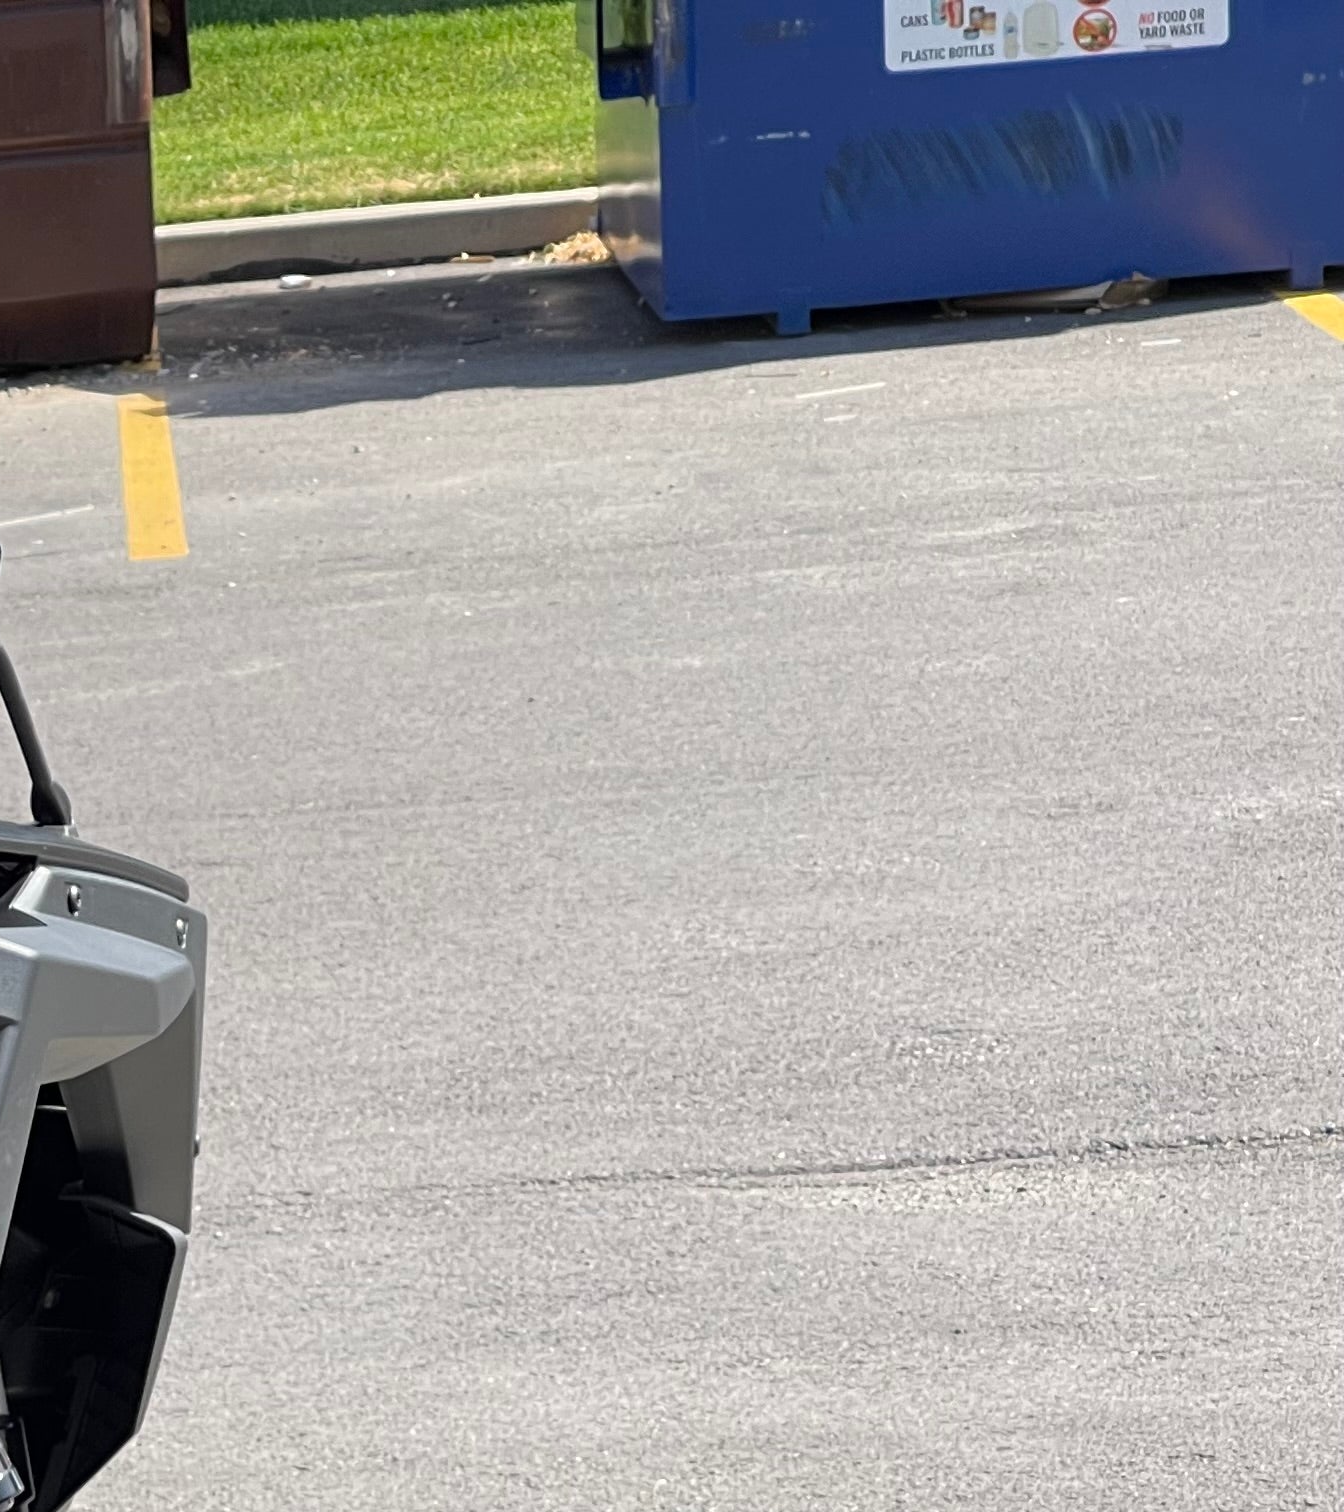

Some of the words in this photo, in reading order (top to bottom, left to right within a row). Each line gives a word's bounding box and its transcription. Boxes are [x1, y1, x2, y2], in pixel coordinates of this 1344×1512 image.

[900, 14, 928, 28] CANS
[1139, 12, 1154, 25] NO
[1157, 10, 1186, 24] FOOD
[1189, 8, 1205, 20] OR
[1139, 26, 1166, 39] YARD
[1170, 22, 1205, 37] WASTE
[901, 47, 945, 63] PLASTIC
[949, 44, 995, 59] BOTTLES
